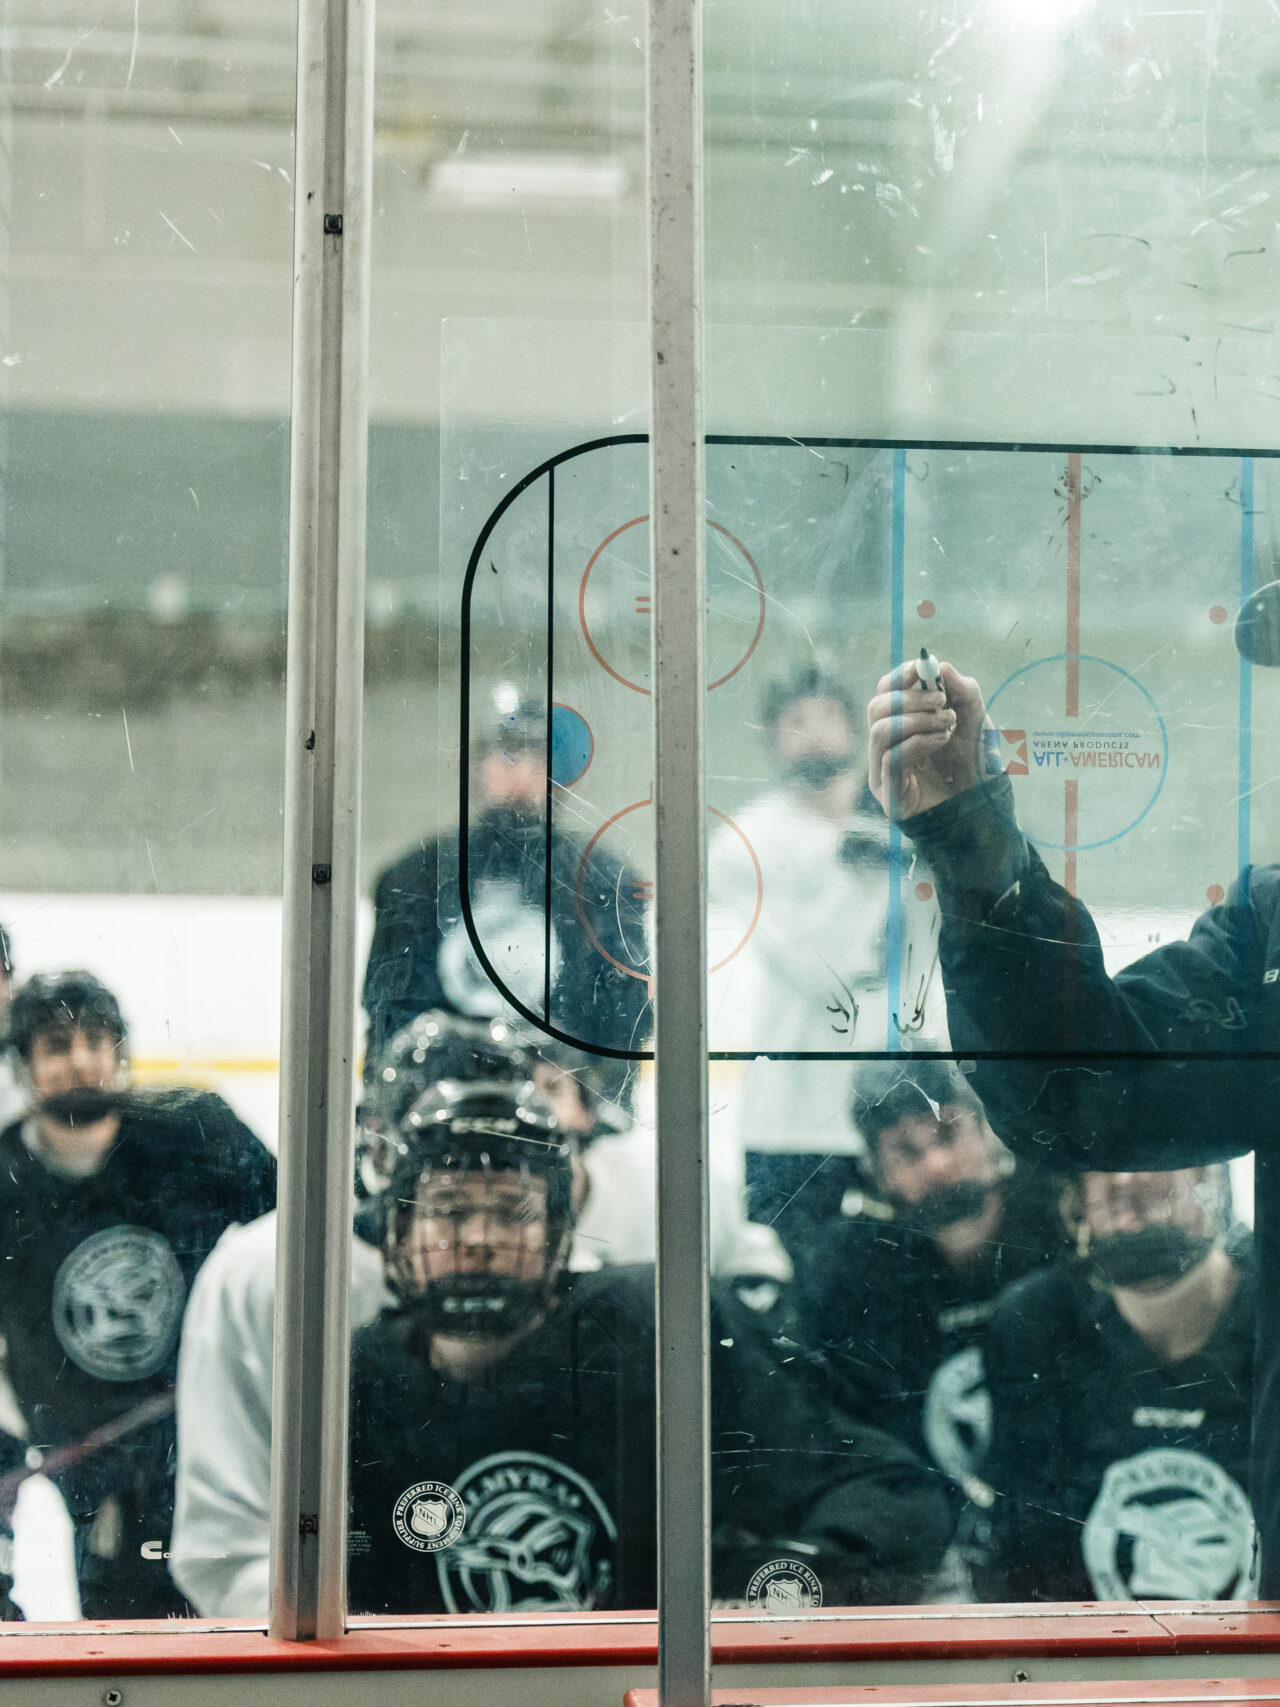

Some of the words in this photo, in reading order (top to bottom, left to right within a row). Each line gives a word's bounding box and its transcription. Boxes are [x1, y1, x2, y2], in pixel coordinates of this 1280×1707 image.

[396, 1483, 434, 1516] PREFERRED
[435, 1484, 450, 1496] ICE
[448, 1493, 463, 1514] RINK
[418, 1507, 440, 1529] NHL
[396, 1519, 425, 1549] SUPPLIER
[749, 1562, 788, 1596] PREFERRED
[789, 1563, 804, 1574] ICE
[803, 1571, 819, 1593] RINK
